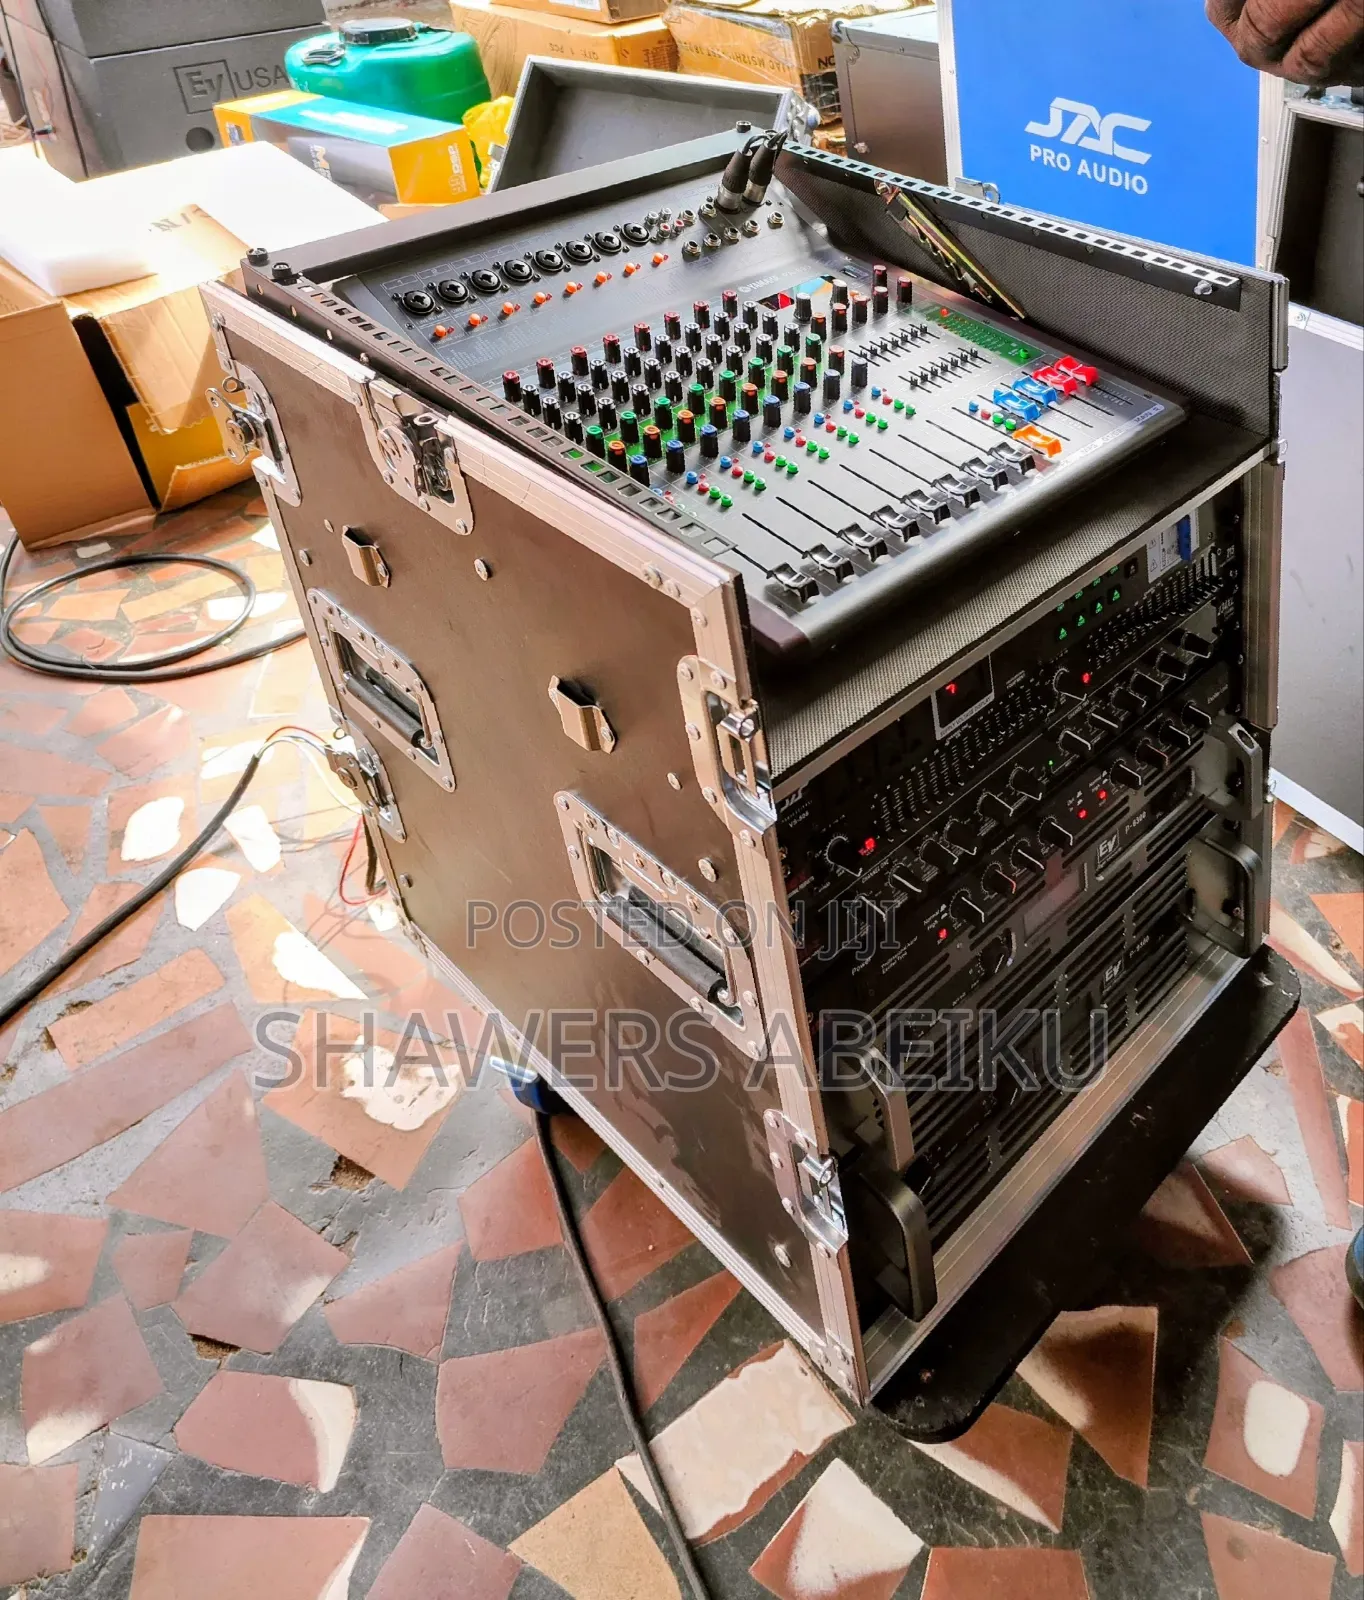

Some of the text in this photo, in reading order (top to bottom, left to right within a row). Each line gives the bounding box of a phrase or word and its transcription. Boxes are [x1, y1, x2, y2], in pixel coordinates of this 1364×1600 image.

[233, 64, 290, 91] USA
[1030, 144, 1148, 195] PRO AUDIO
